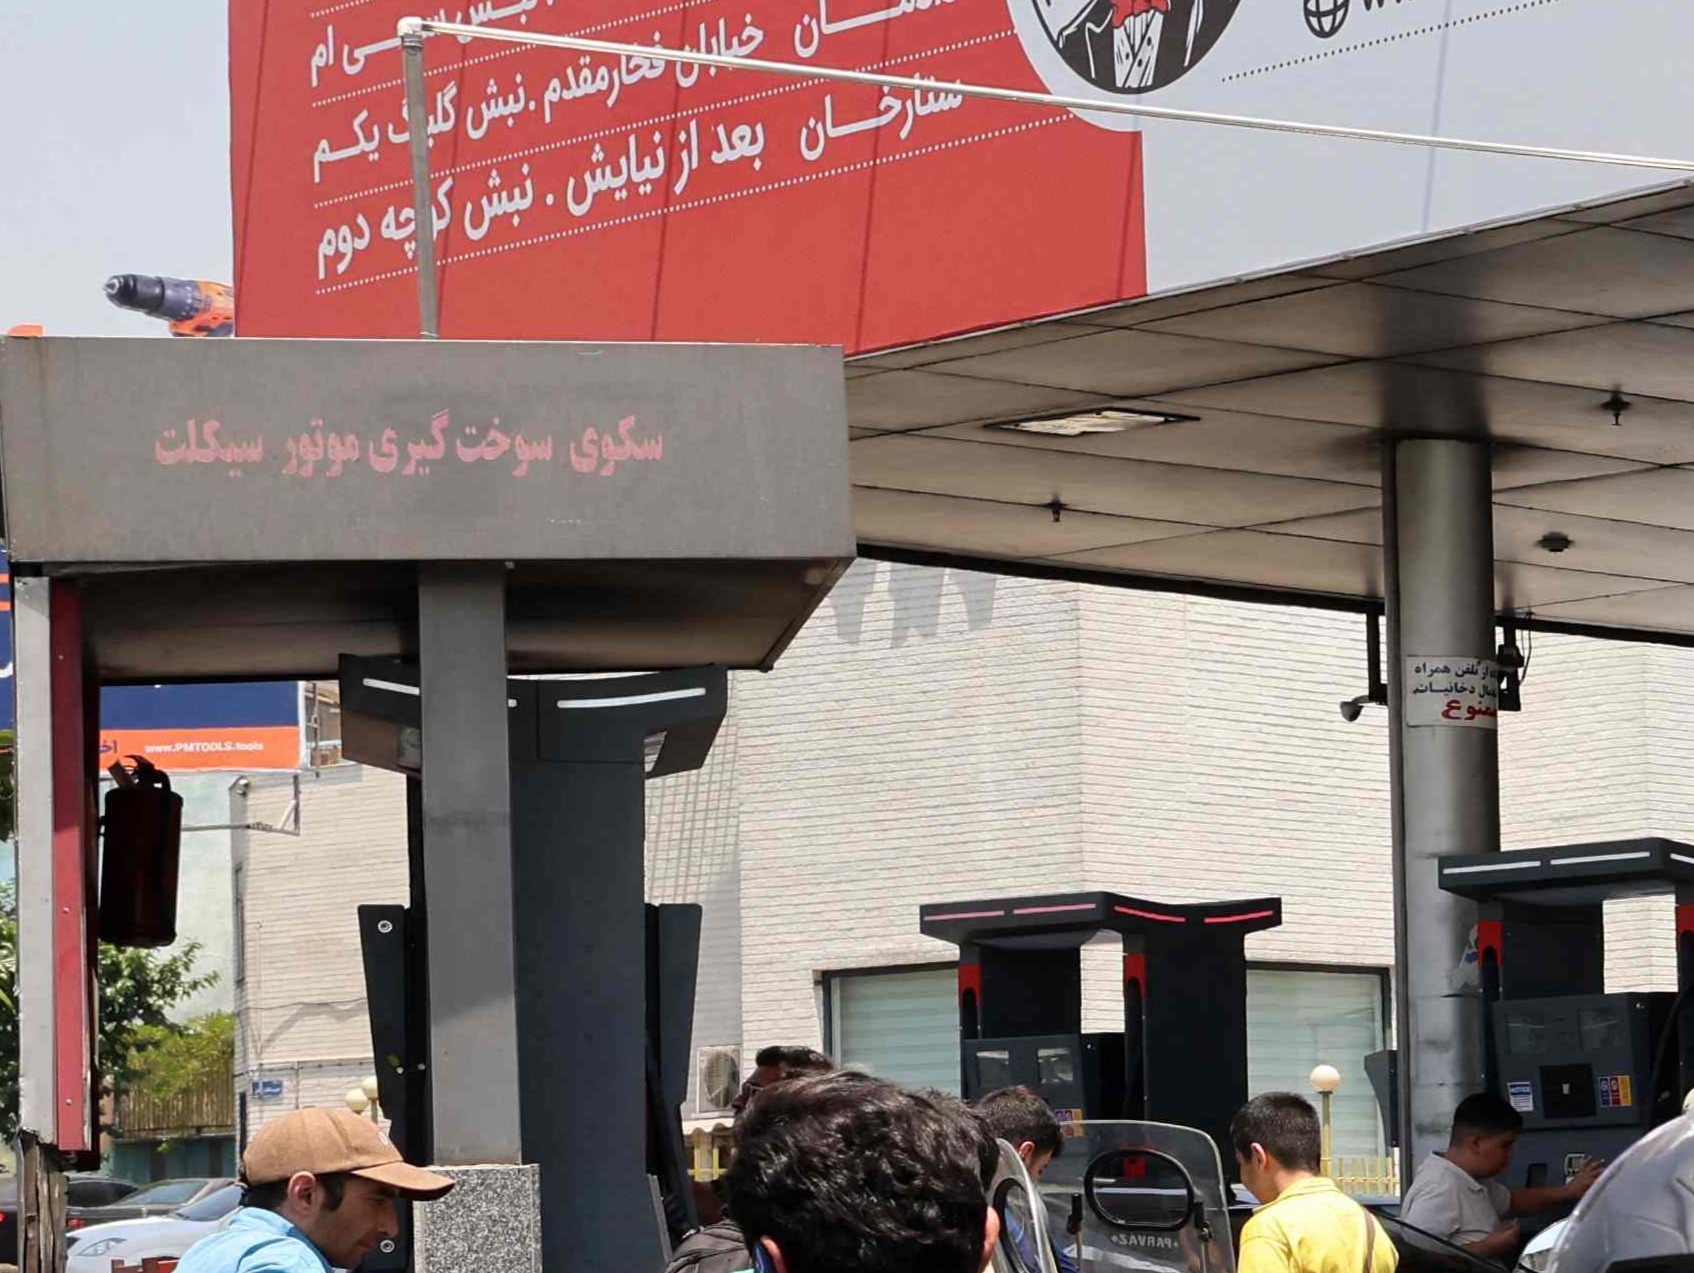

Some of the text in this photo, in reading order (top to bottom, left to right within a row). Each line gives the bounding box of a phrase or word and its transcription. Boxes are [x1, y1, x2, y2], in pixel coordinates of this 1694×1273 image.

[566, 131, 665, 216] نیایش
[673, 119, 698, 195] از
[710, 121, 765, 172] بعد
[463, 162, 534, 241] نبش
[317, 214, 371, 280] دوم
[154, 408, 664, 478] سکوی سوخت گیری موتور سیکلت
